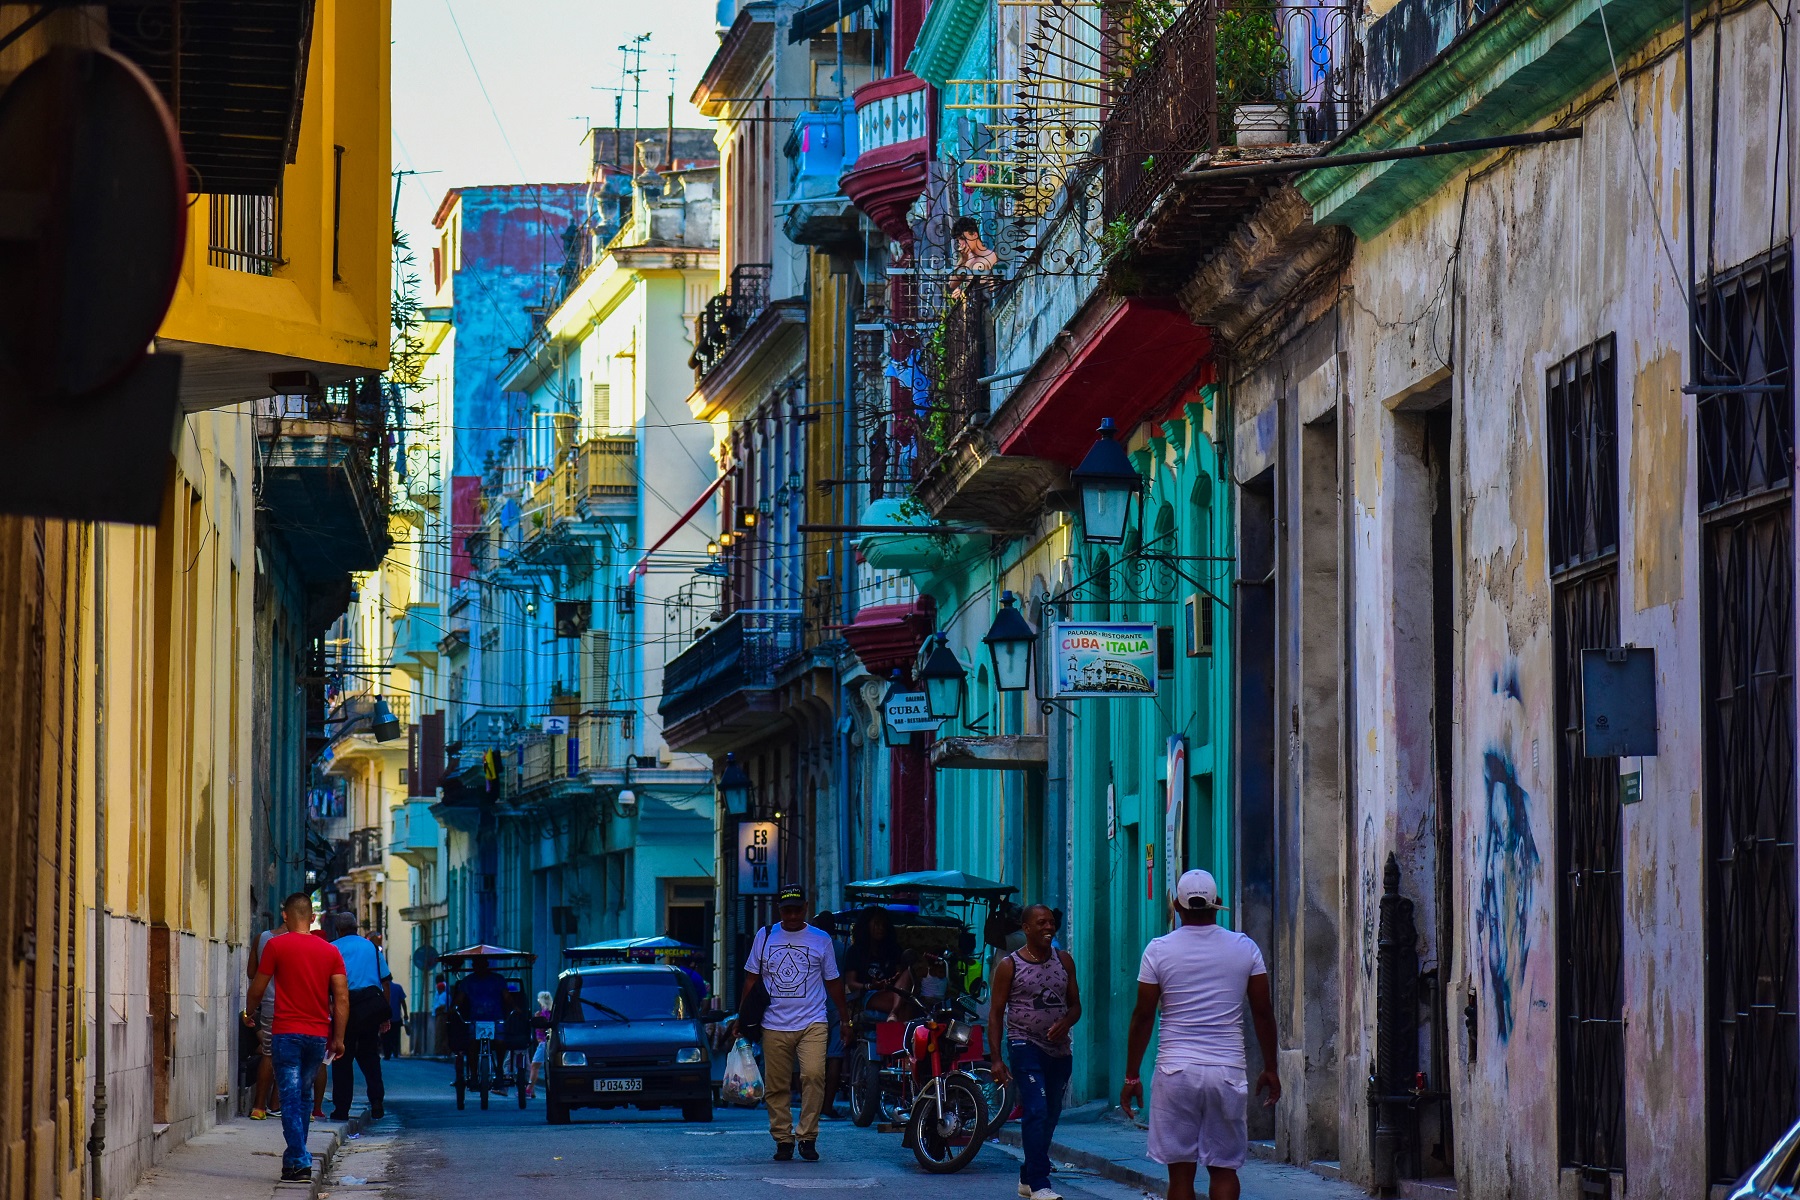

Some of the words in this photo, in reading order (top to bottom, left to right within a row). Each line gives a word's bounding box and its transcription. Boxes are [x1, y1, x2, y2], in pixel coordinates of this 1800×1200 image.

[1062, 637, 1100, 650] CUBA
[1106, 640, 1149, 653] ITALIA
[889, 705, 920, 715] CUBA
[754, 829, 767, 845] ES
[745, 844, 767, 865] QUI
[753, 865, 769, 881] NA
[600, 1080, 606, 1091] P
[607, 1080, 623, 1091] 034
[625, 1080, 641, 1090] 393
